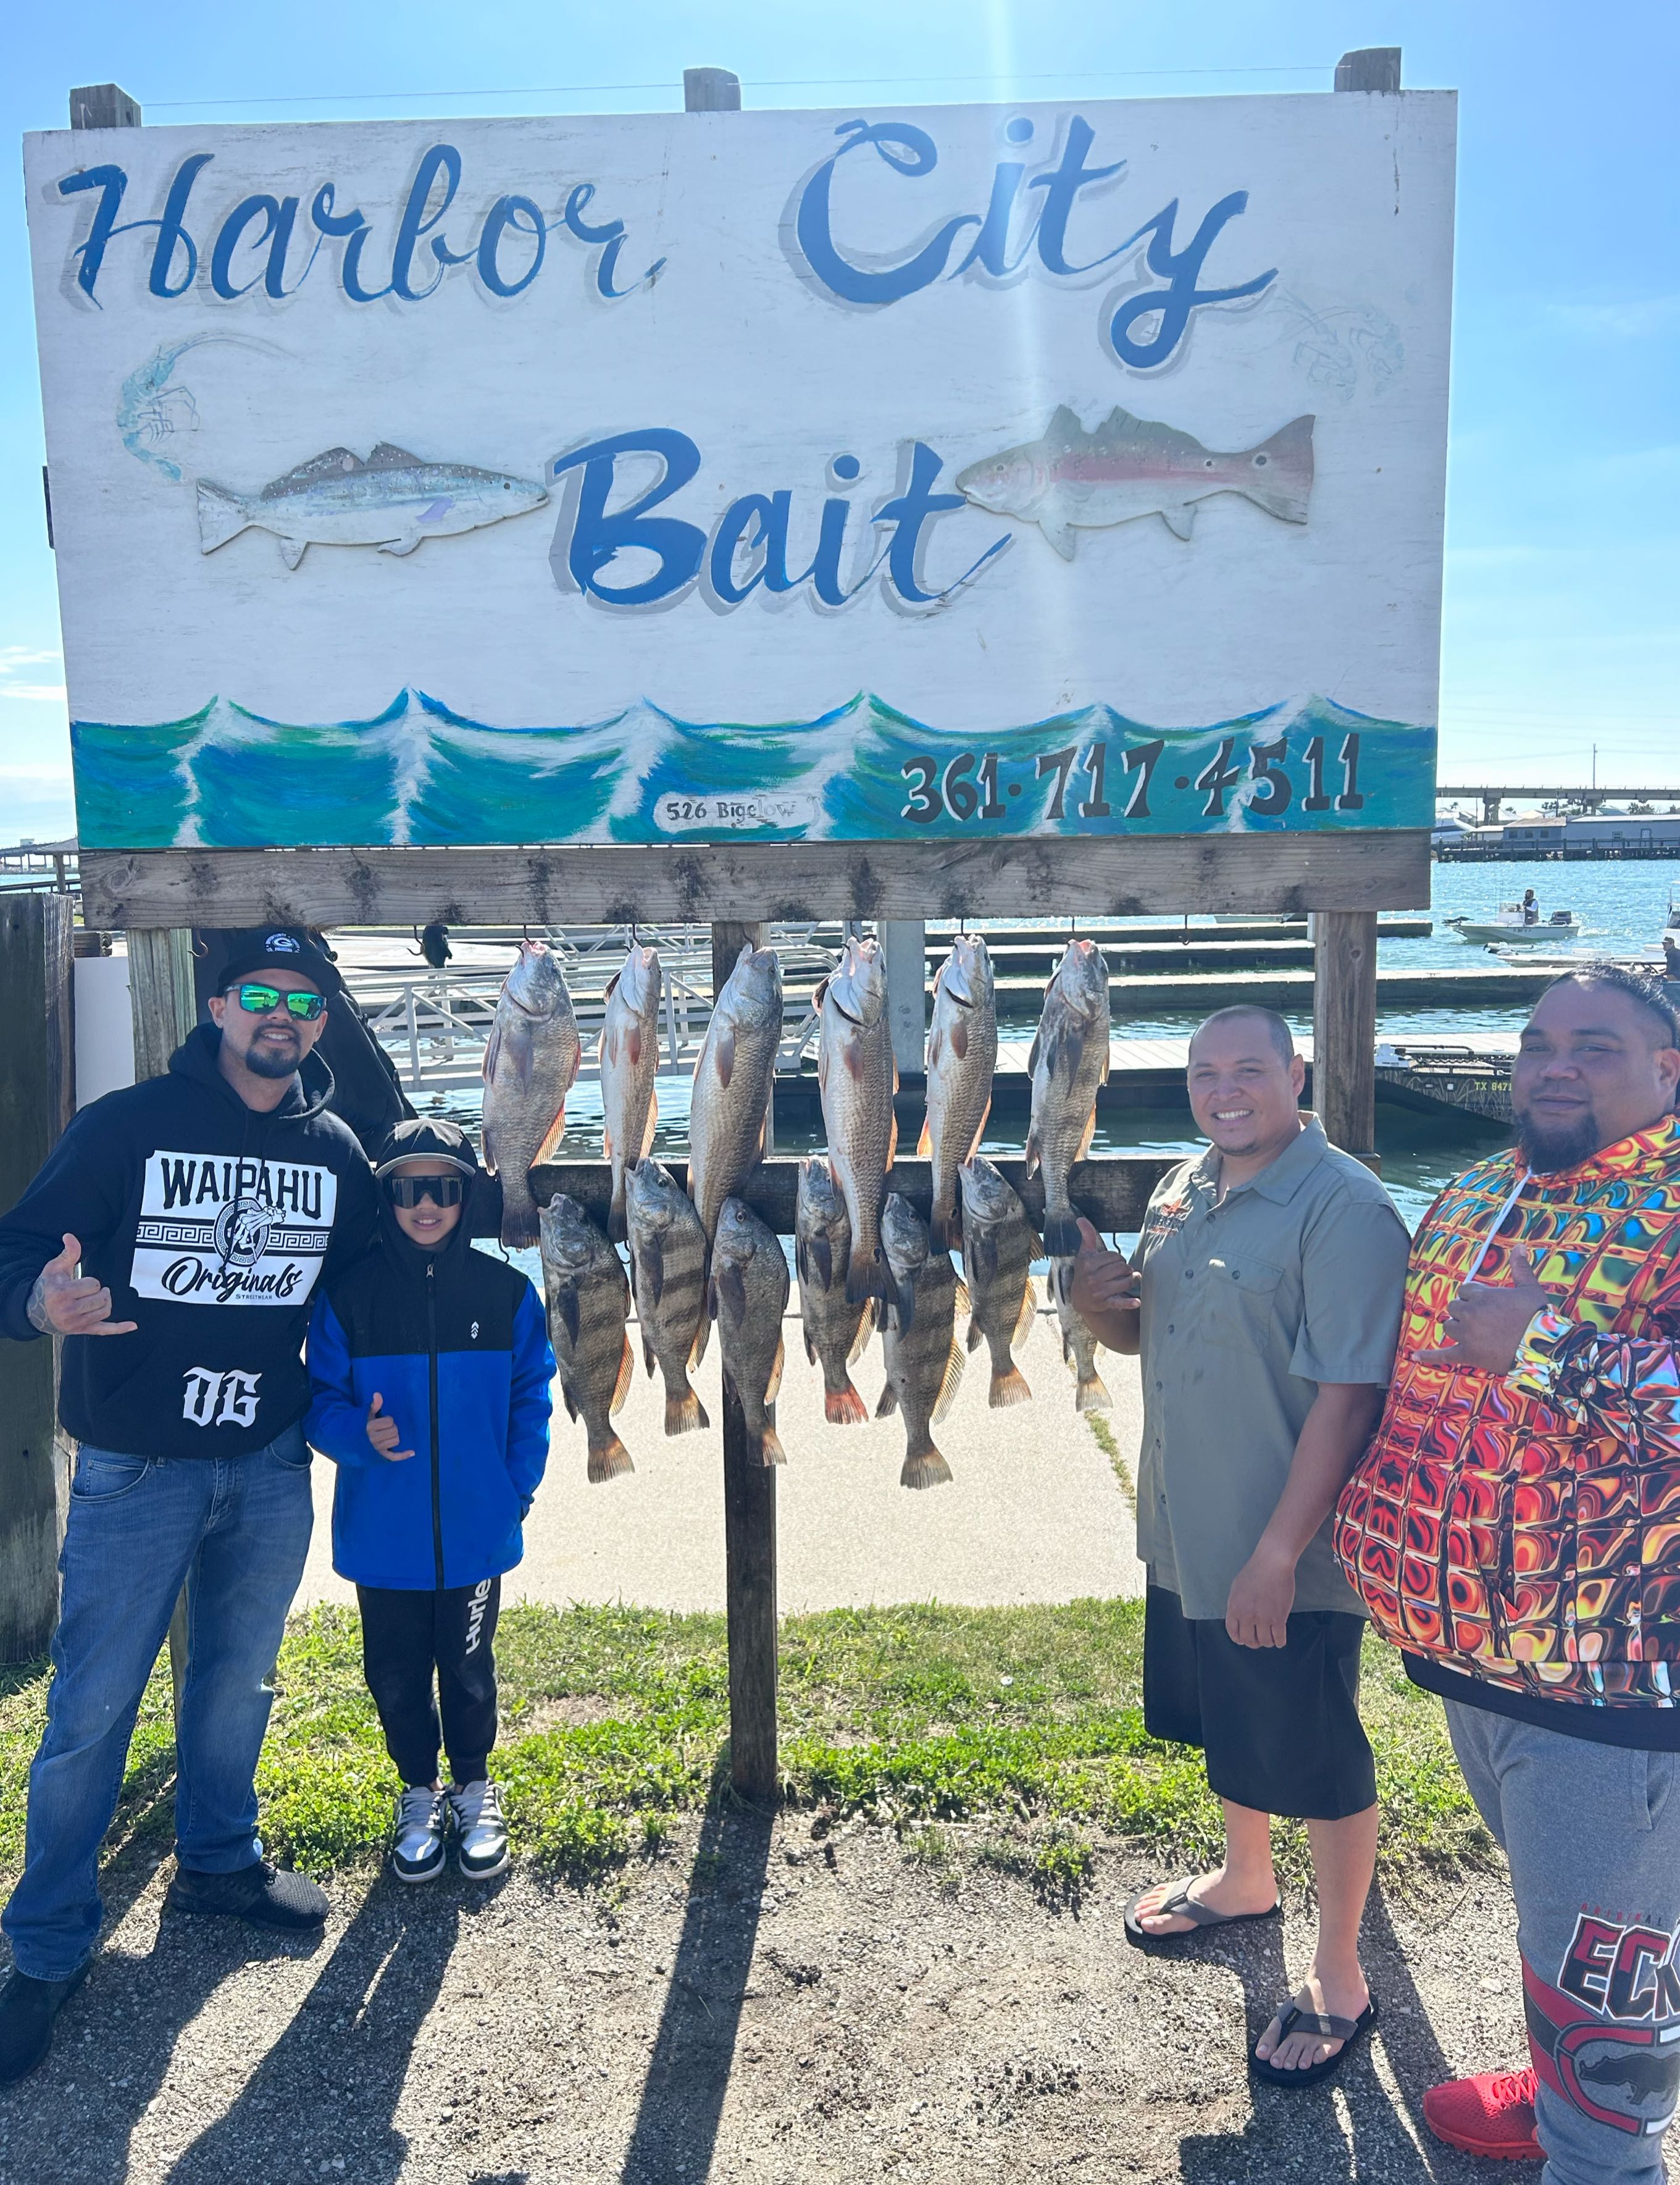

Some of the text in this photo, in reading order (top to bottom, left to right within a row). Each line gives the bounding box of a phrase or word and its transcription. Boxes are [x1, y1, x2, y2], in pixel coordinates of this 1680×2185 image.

[54, 114, 1279, 371] Harbor City
[550, 427, 1013, 608] Bait
[666, 802, 707, 821] 526
[1474, 1081, 1487, 1091] TX
[161, 1158, 322, 1220] WAIPAHU
[161, 1256, 303, 1303] Originals
[182, 1365, 262, 1428] OG
